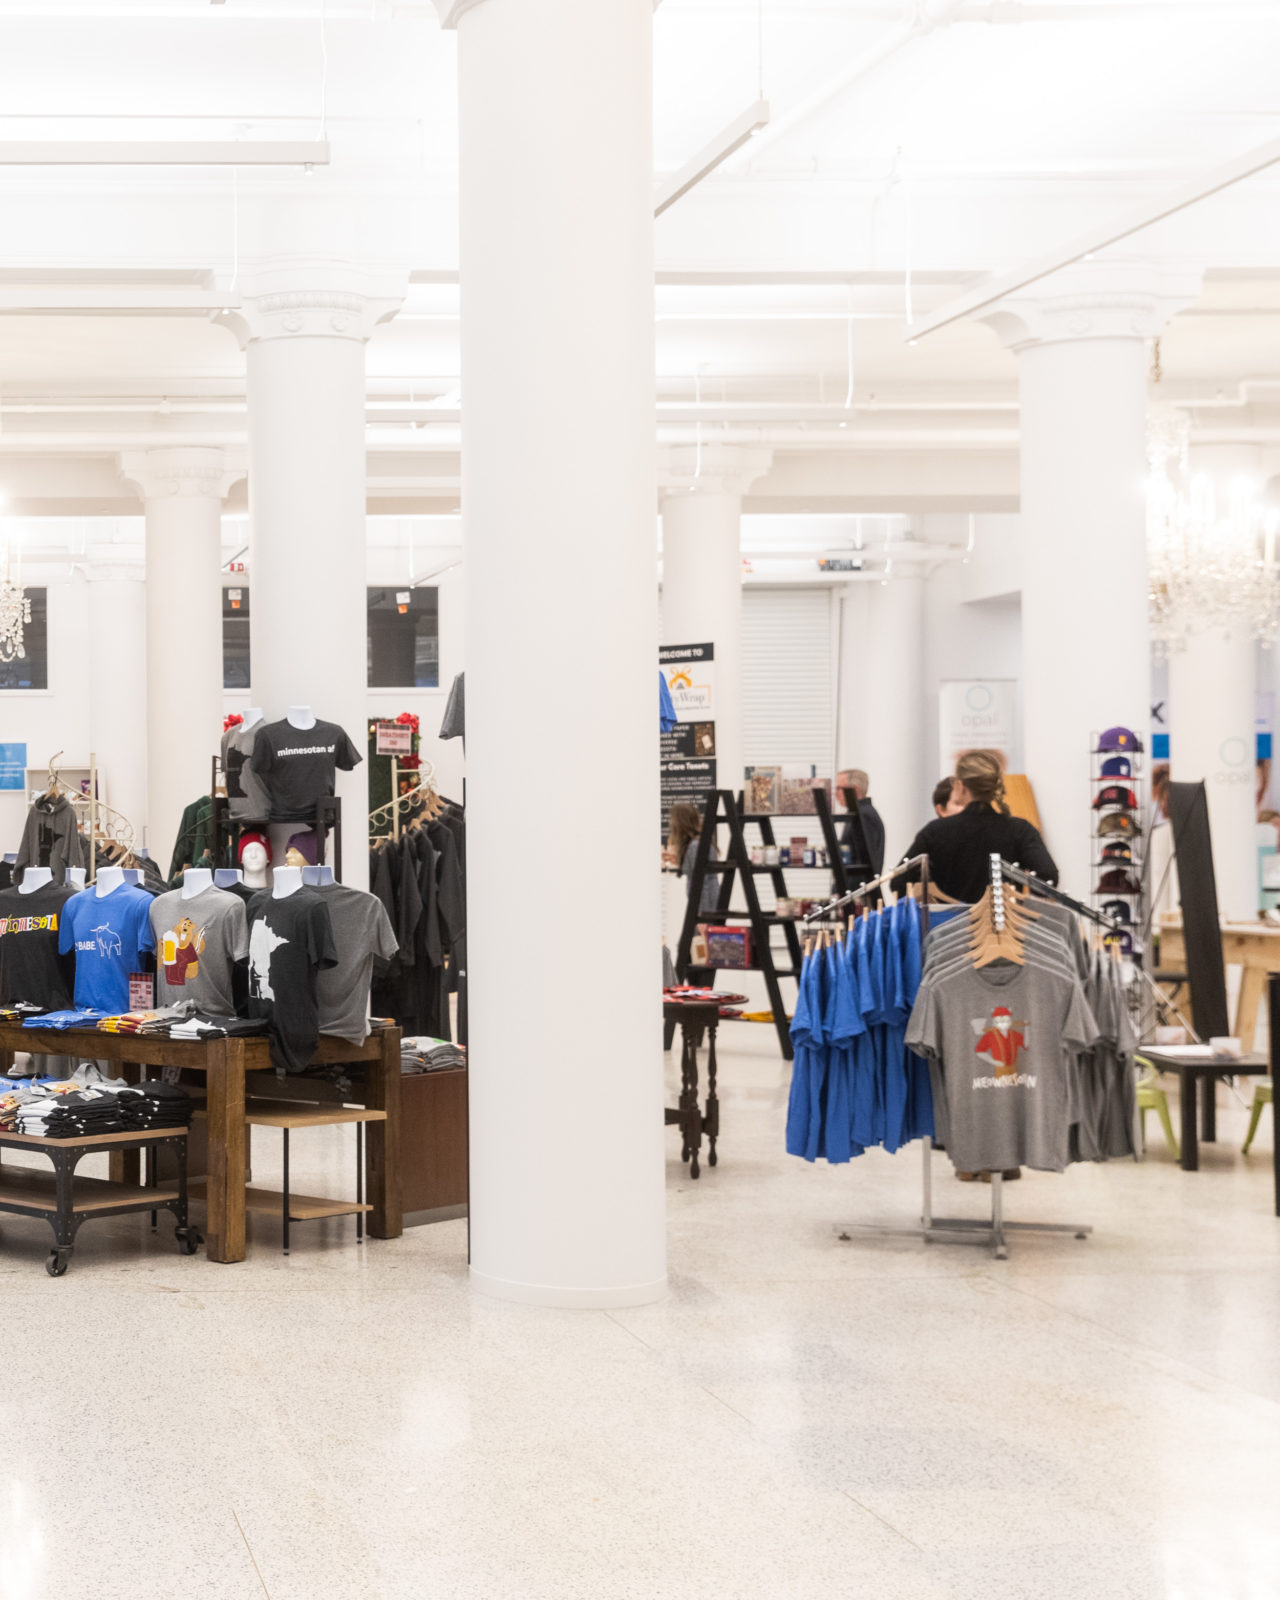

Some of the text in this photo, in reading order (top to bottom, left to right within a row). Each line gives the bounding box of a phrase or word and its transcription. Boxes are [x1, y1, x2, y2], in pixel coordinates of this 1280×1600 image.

[691, 648, 704, 657] TO
[277, 744, 336, 757] minnesotan af
